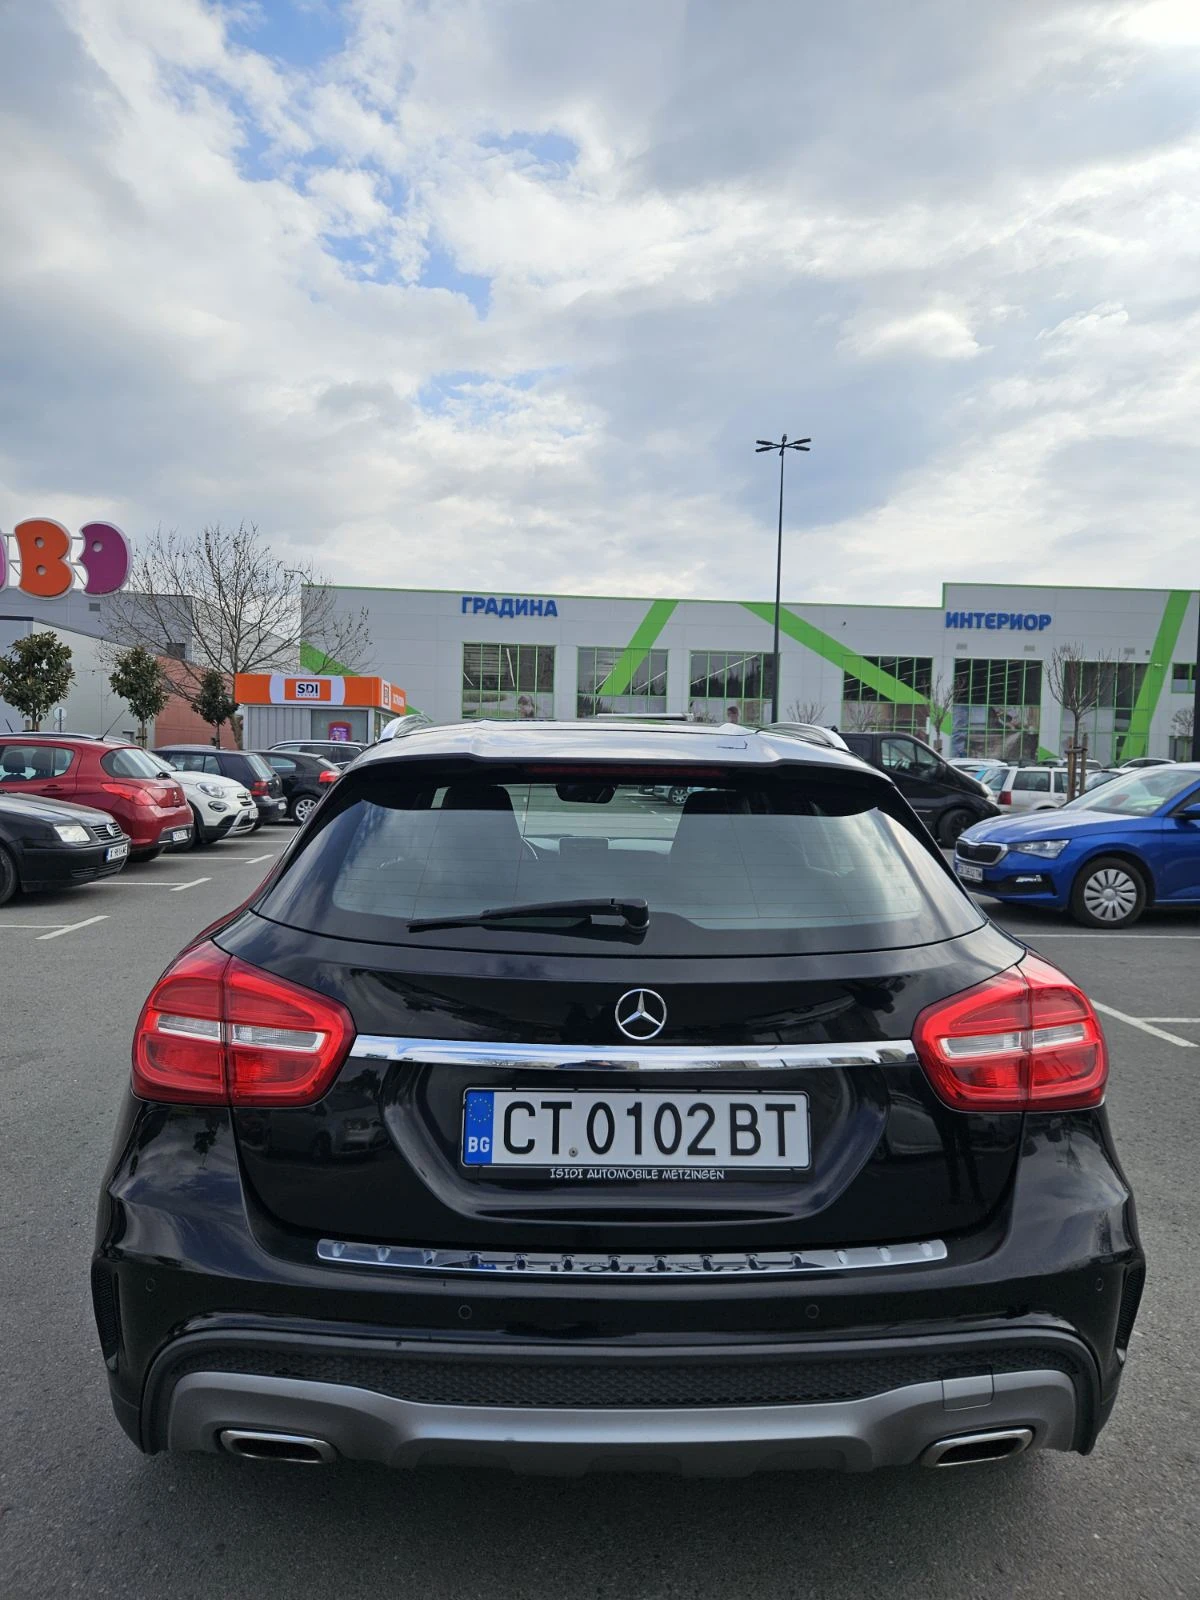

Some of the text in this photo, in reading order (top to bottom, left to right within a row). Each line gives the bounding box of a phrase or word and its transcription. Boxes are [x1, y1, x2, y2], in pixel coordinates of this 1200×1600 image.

[461, 596, 558, 618] ГРАДИНА
[945, 611, 1052, 631] ИНТЕРИОР
[297, 683, 319, 694] SDI
[468, 1136, 490, 1153] BG
[587, 1168, 659, 1179] AUTOMOBILE
[662, 1169, 725, 1180] METZINGEN
